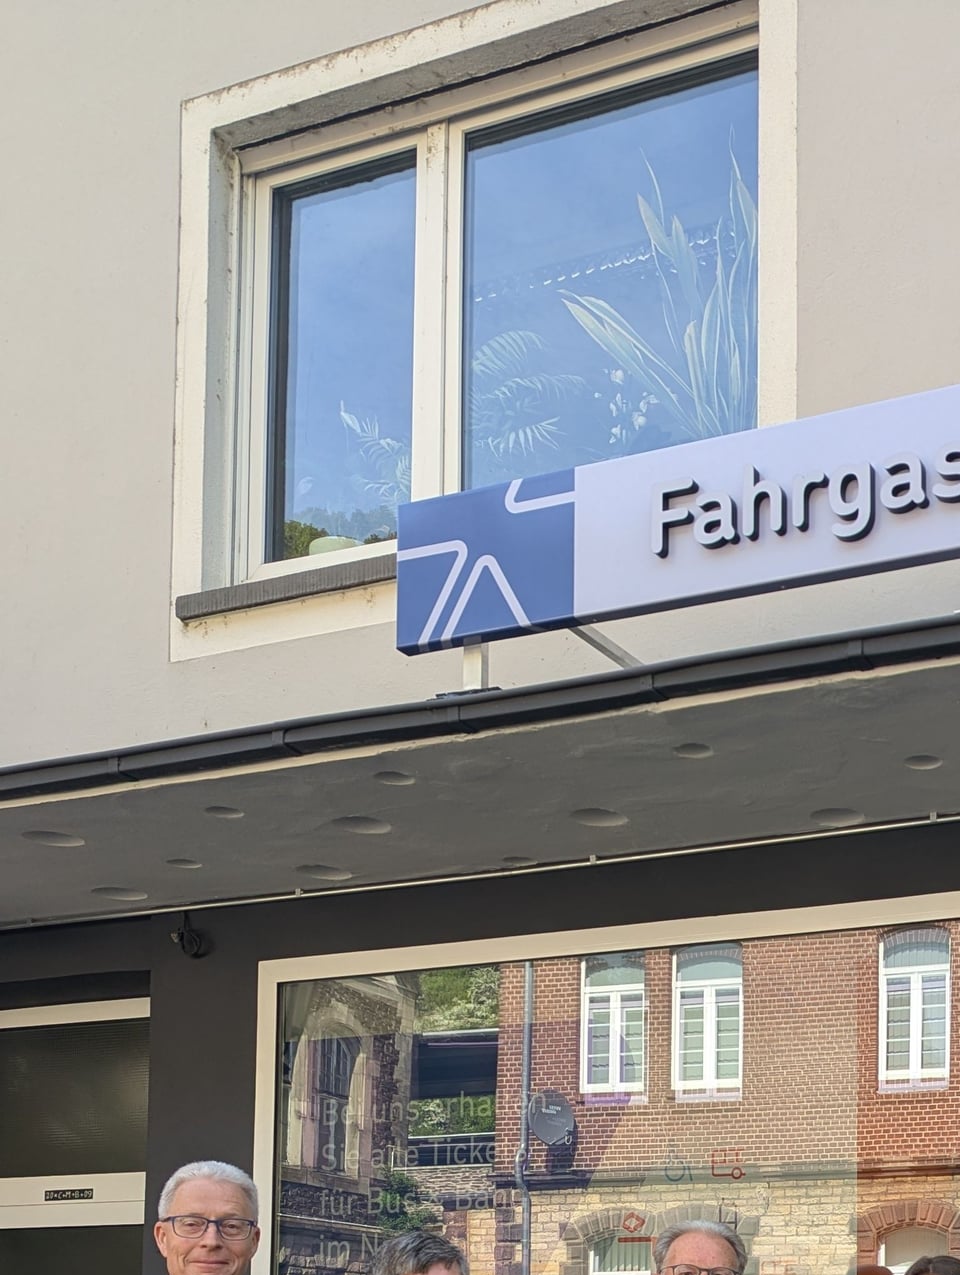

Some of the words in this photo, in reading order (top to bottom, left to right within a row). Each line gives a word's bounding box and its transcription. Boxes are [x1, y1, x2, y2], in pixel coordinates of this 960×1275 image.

[322, 1098, 362, 1126] Be
[427, 1134, 526, 1166] Ticke
[320, 1187, 355, 1217] für
[320, 1234, 350, 1268] im
